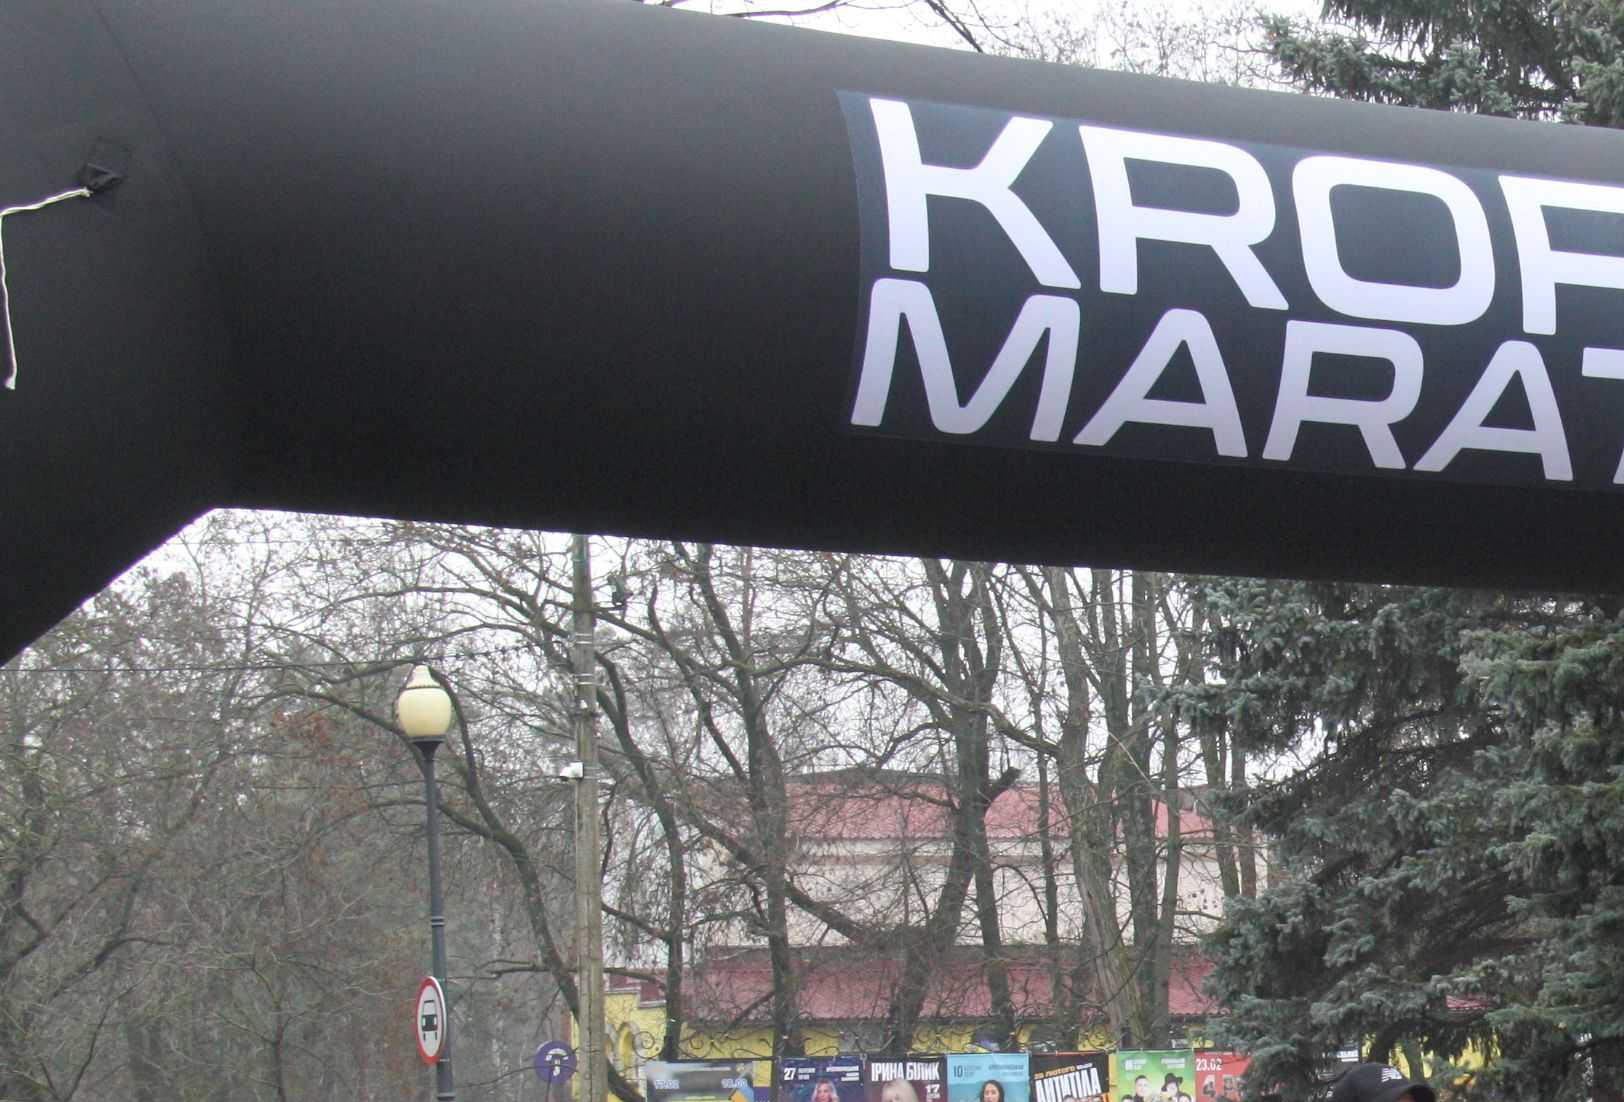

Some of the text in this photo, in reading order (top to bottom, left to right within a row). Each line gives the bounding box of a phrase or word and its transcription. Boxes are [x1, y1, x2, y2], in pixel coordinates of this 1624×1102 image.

[1195, 1058, 1222, 1071] 23.02
[783, 1067, 796, 1080] 27
[871, 1062, 905, 1081] ІРИНА
[906, 1062, 940, 1080] БІЛИК
[925, 1084, 940, 1093] 17
